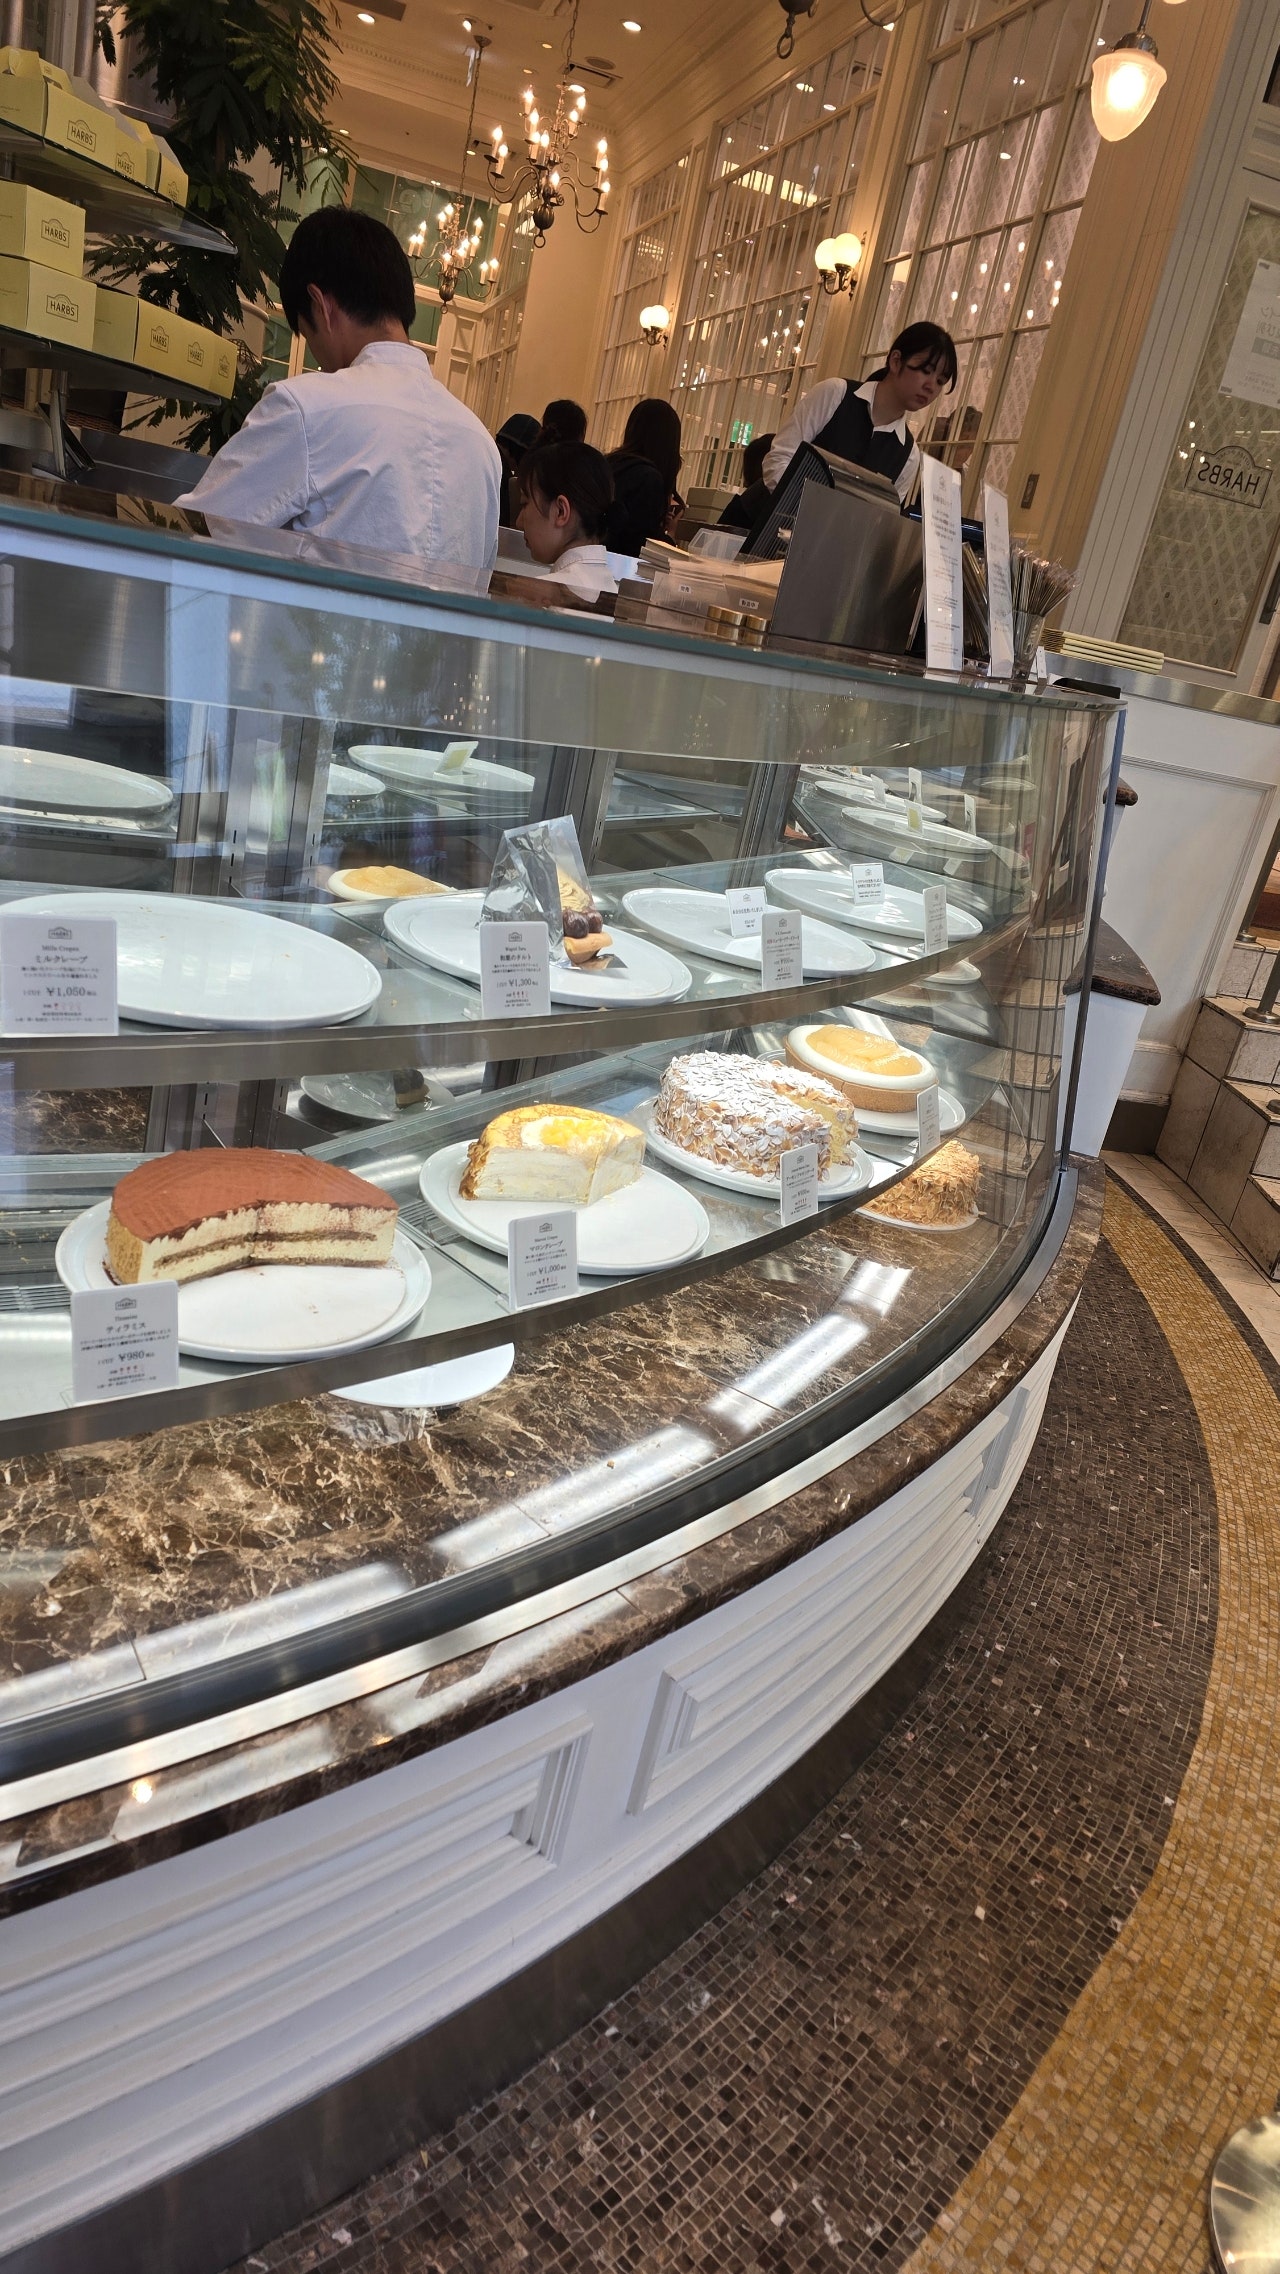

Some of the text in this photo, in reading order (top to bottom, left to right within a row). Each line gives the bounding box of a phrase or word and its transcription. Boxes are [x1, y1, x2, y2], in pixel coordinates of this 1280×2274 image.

[70, 127, 94, 146] HARBS
[117, 159, 133, 175] HARBS
[44, 226, 68, 243] HARBS
[50, 300, 76, 317] HARBS
[152, 332, 168, 348] HARBS
[36, 955, 88, 964] ミルクレープ
[106, 1322, 146, 1334] ティラミス
